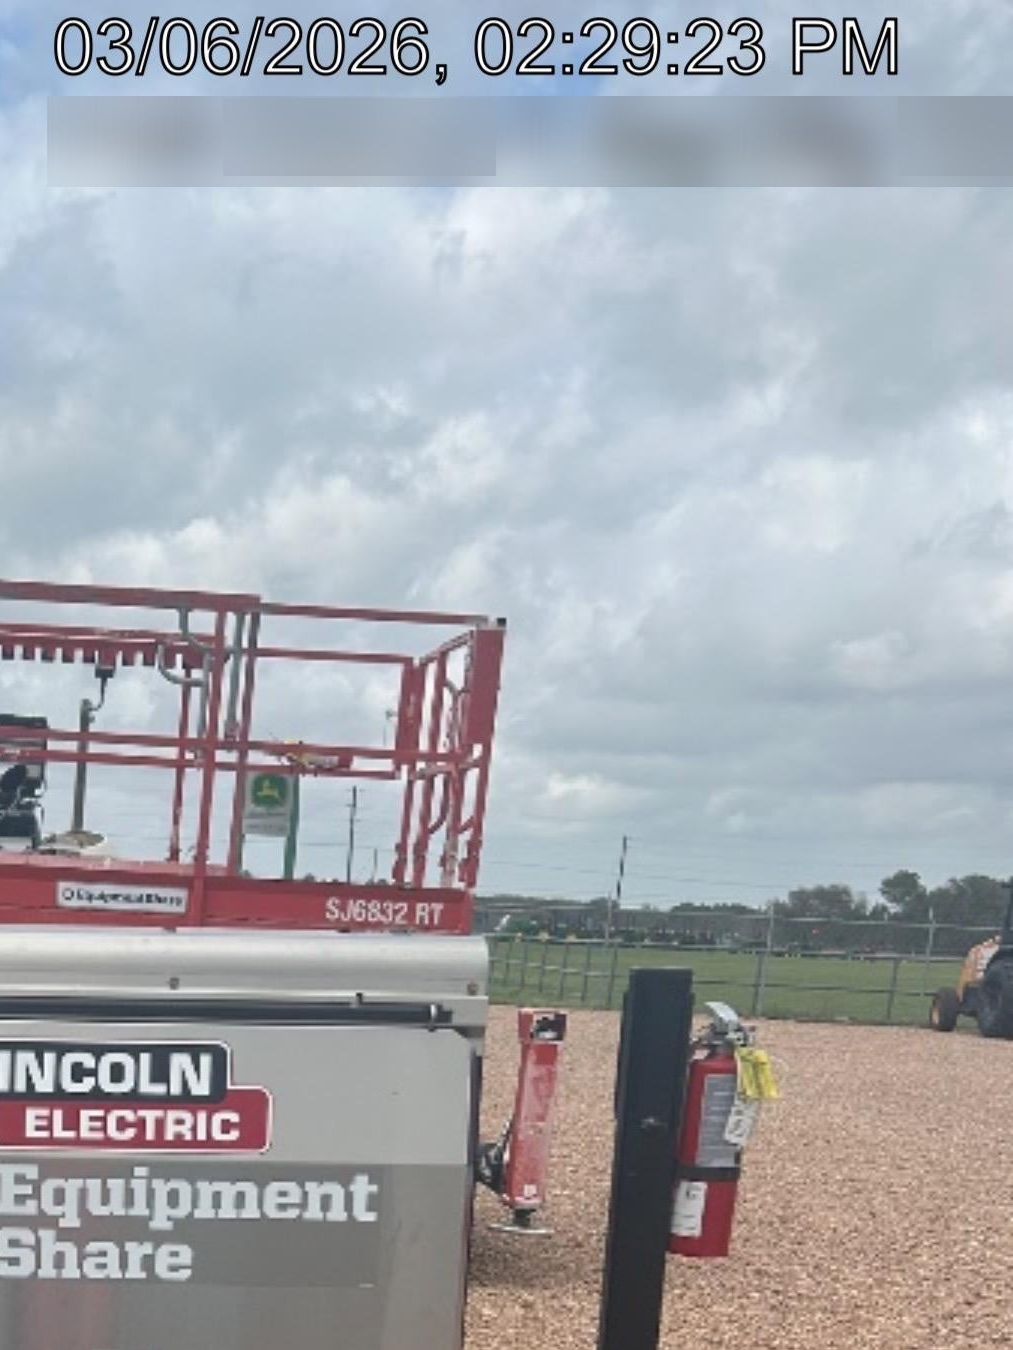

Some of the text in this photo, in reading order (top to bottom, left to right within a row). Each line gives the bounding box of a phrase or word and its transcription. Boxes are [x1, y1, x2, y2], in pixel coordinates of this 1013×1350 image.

[325, 897, 444, 926] SJ6832 RT
[24, 1109, 240, 1141] ELECTRIC
